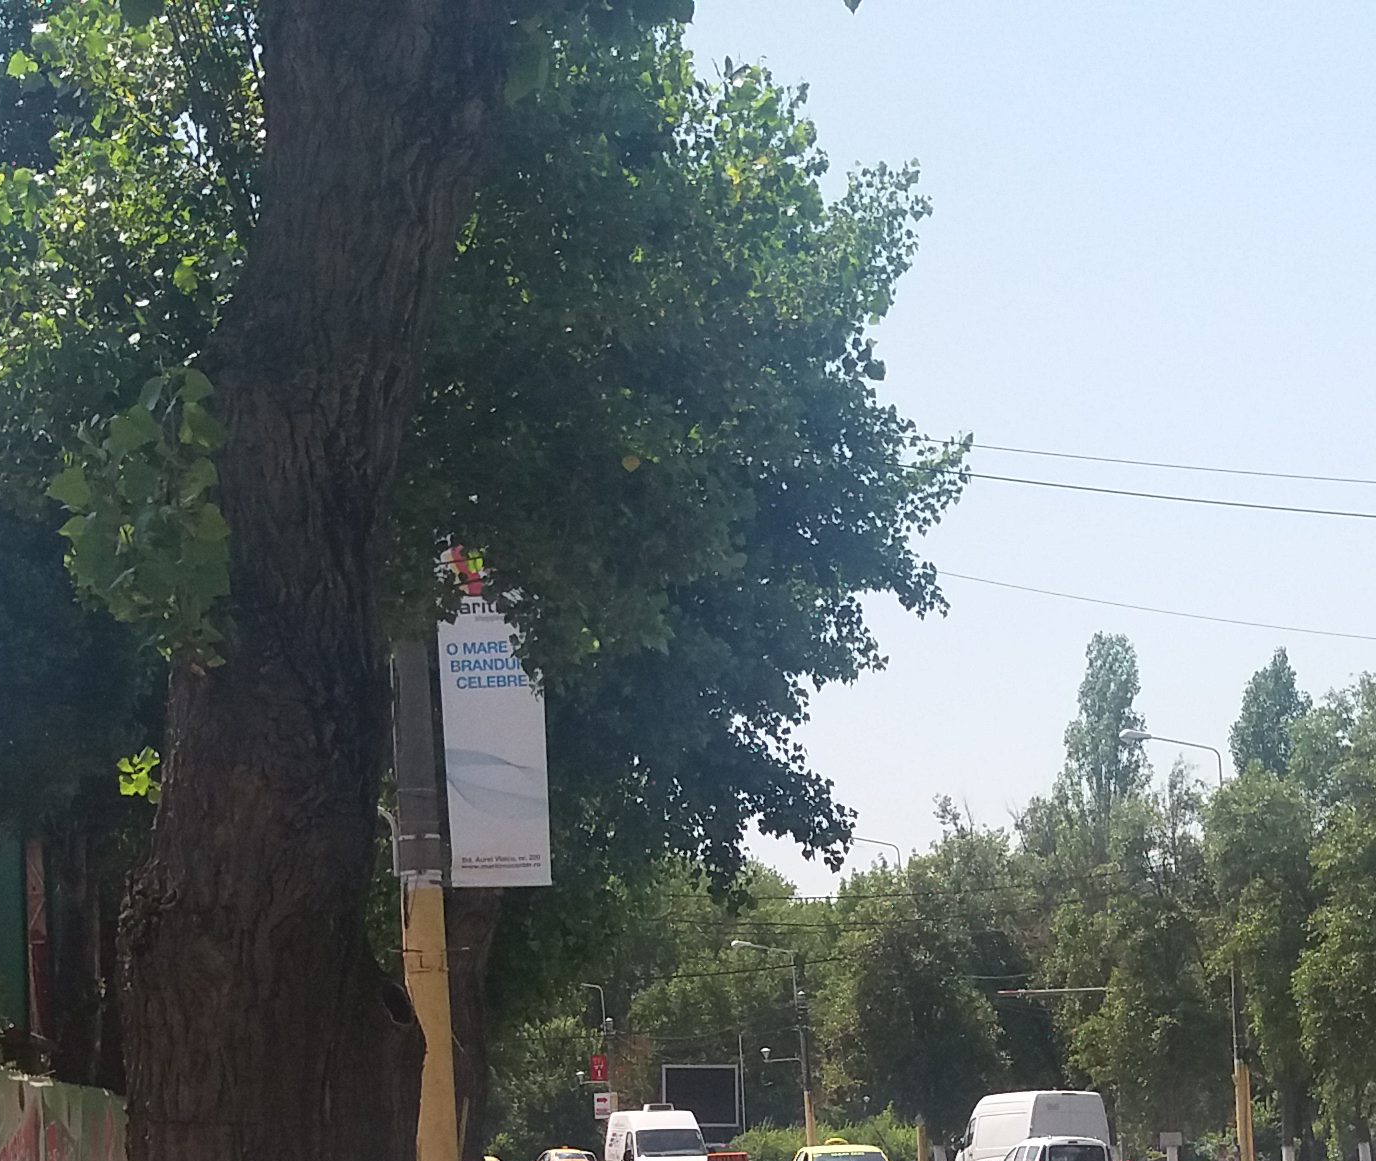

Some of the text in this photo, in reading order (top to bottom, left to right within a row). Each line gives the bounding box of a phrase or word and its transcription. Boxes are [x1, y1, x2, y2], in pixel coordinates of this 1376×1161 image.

[446, 640, 509, 656] O MARE
[456, 674, 528, 690] CELEBRE
